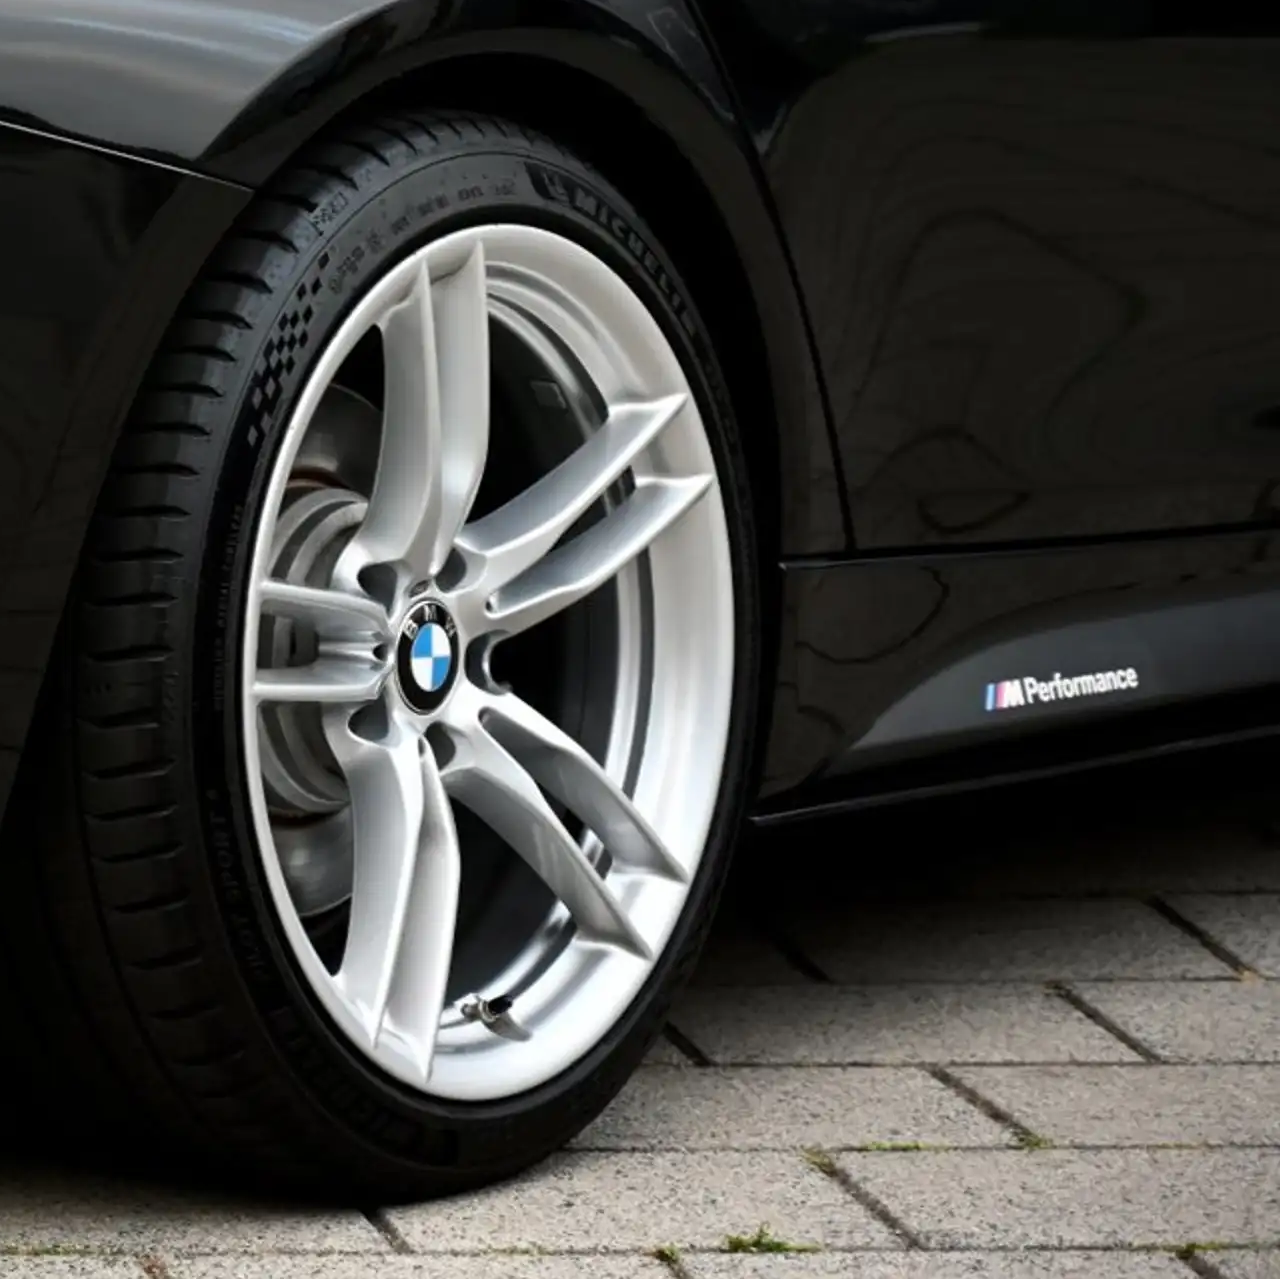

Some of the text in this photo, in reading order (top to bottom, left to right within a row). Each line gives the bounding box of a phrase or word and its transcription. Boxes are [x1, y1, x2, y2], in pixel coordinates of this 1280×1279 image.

[572, 189, 701, 336] MICHELIN
[403, 604, 456, 642] BMW
[1024, 667, 1140, 704] Performance
